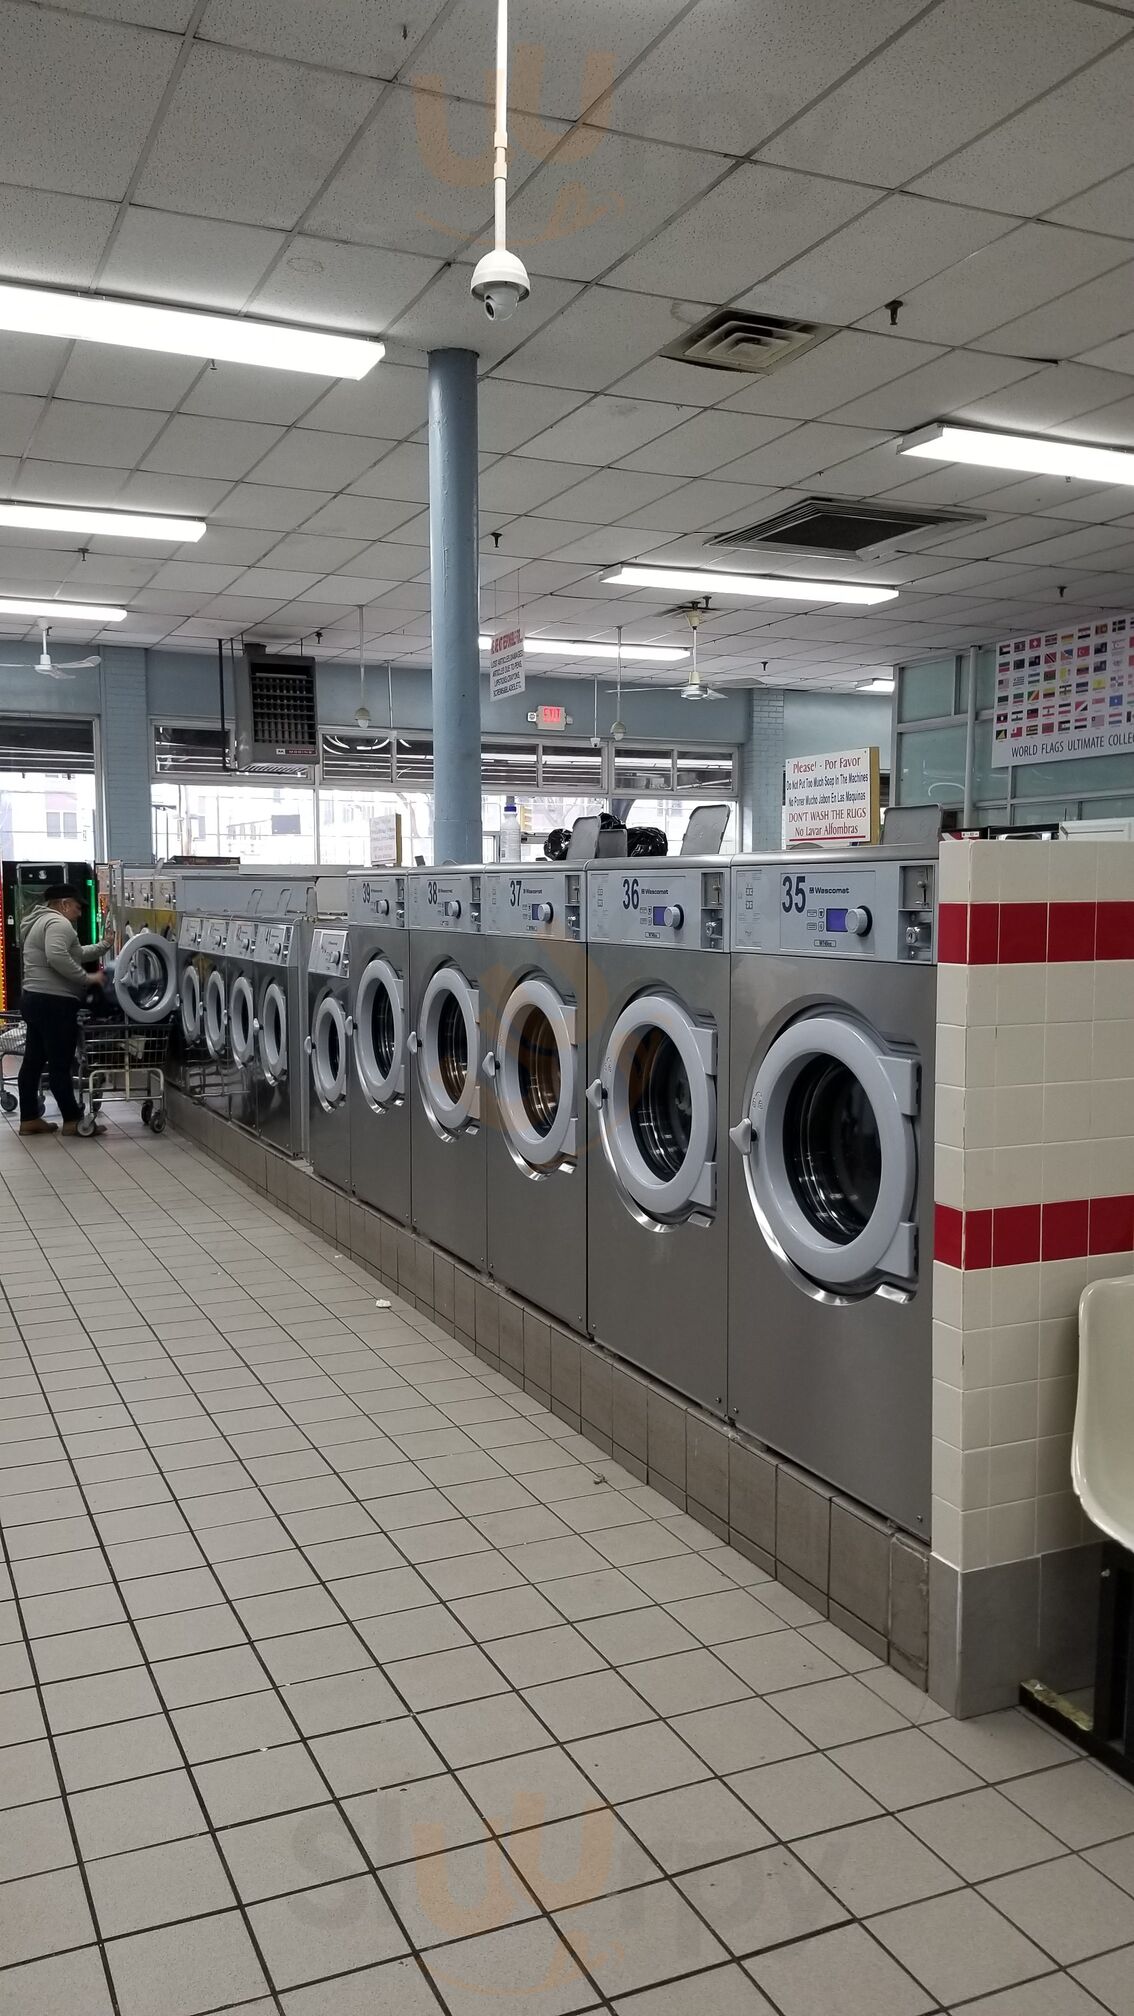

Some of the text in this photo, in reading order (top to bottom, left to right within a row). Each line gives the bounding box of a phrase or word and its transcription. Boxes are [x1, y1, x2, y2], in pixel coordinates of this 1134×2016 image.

[544, 708, 560, 722] EXIT
[1011, 732, 1134, 758] WORLD FLAGS ULTIMATE COLLE
[793, 761, 817, 774] Please!
[824, 759, 837, 770] Por
[840, 757, 861, 768] Favor
[786, 780, 791, 790] Do
[814, 776, 824, 787] Much
[824, 776, 834, 788] Soap
[835, 776, 839, 785] In
[840, 774, 848, 784] The
[848, 772, 868, 784] Machines
[846, 790, 866, 804] Maquinas
[788, 808, 867, 822] DON'T WASH THE RUGS
[795, 822, 858, 836] No Lavar Alfombras
[362, 882, 371, 904] 39
[428, 881, 438, 905] 38
[510, 880, 522, 907] 37
[622, 878, 640, 910] 36
[781, 875, 806, 913] 35
[815, 887, 850, 895] Wascomat
